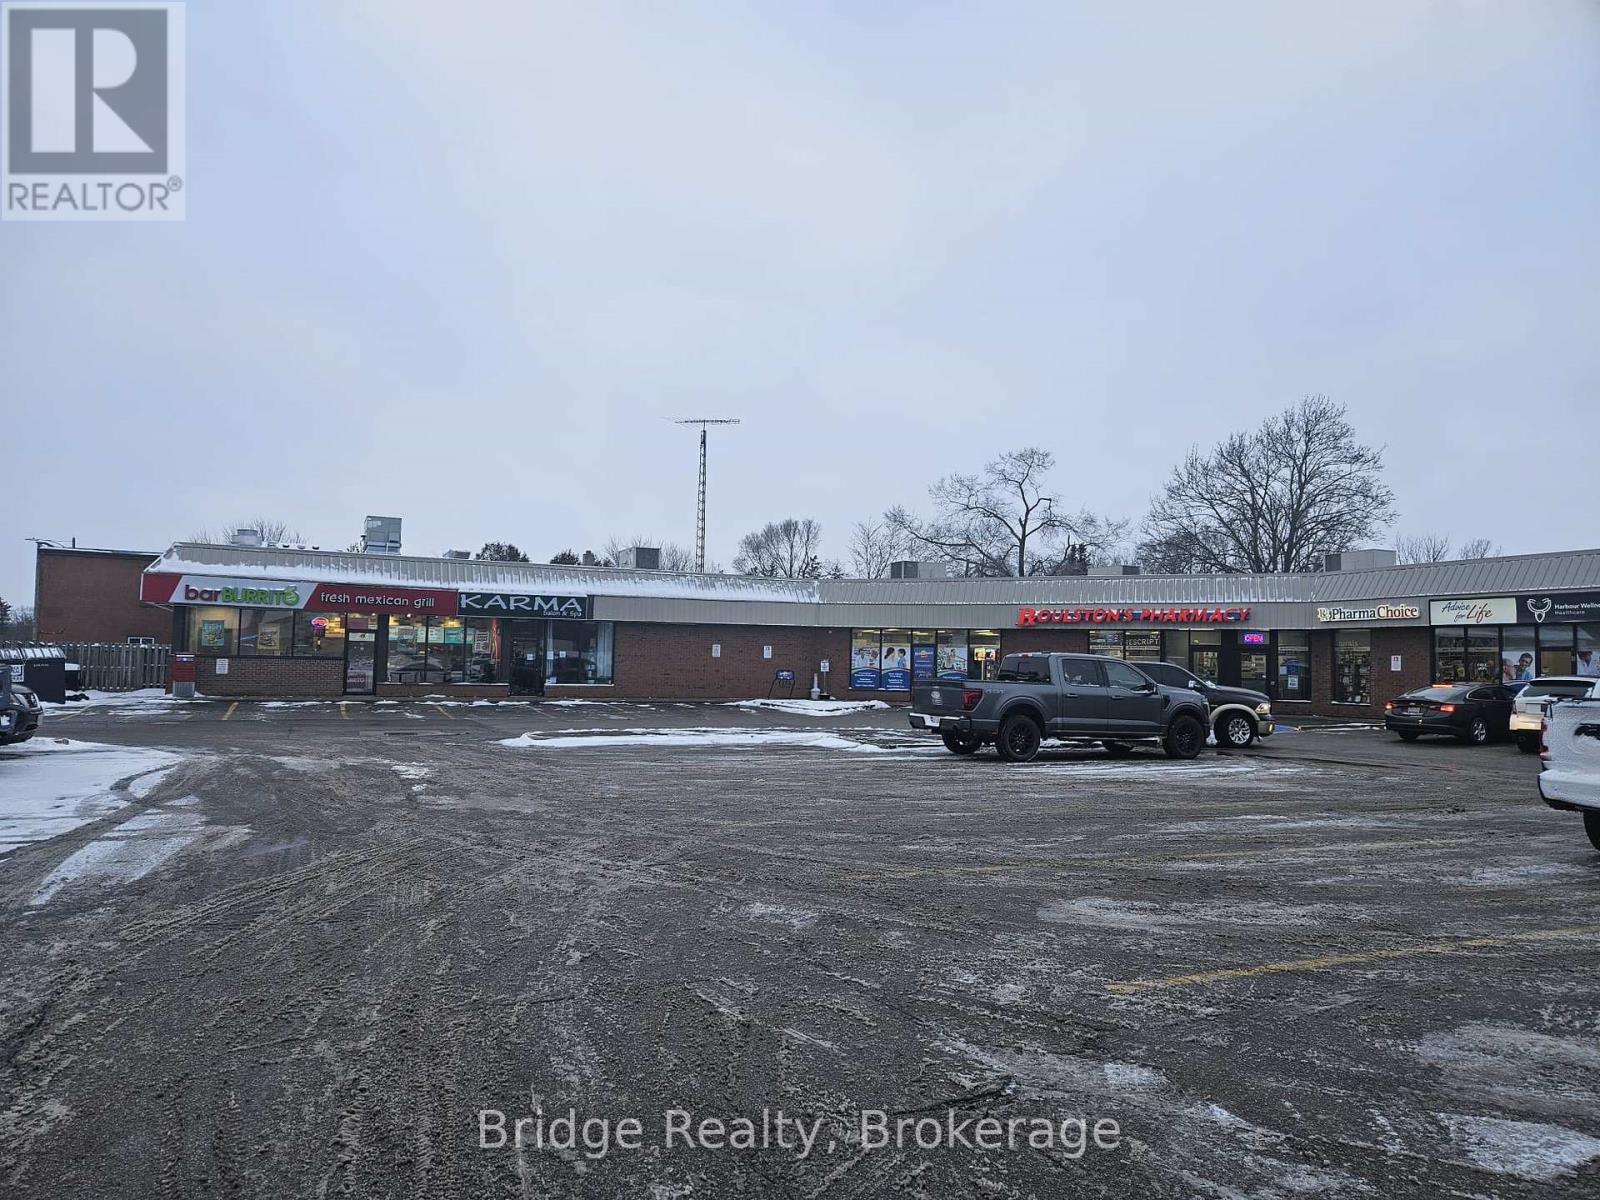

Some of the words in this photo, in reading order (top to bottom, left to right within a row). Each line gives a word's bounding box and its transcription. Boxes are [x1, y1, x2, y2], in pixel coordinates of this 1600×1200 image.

[321, 592, 350, 603] fresh
[355, 595, 409, 606] mexican
[414, 597, 434, 609] grill
[460, 594, 582, 612] KARMA
[1441, 601, 1471, 612] Advice
[1140, 607, 1252, 624] PHARMACY
[1466, 603, 1493, 624] Life
